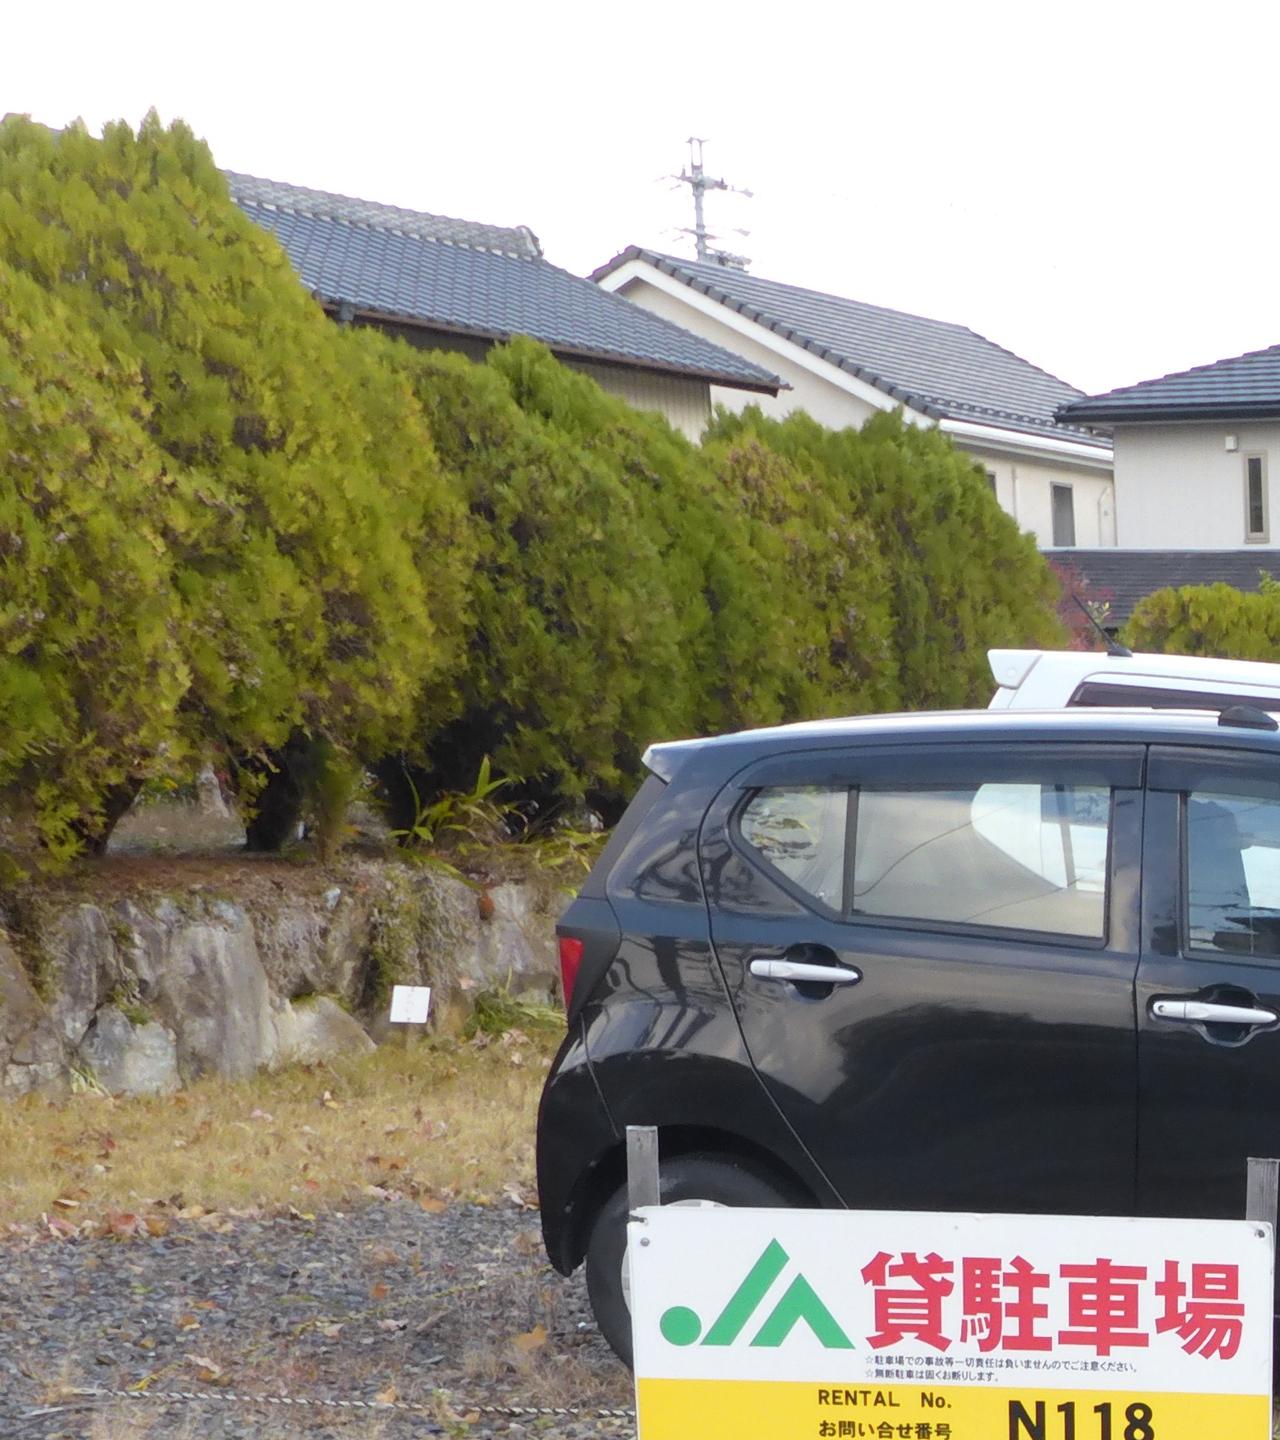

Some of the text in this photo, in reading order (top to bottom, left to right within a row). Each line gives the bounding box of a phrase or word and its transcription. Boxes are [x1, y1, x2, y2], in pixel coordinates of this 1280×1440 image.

[860, 1251, 1245, 1360] 貸駐車場
[818, 1389, 952, 1409] RENTAL No.
[819, 1420, 952, 1440] お問い合せ番号
